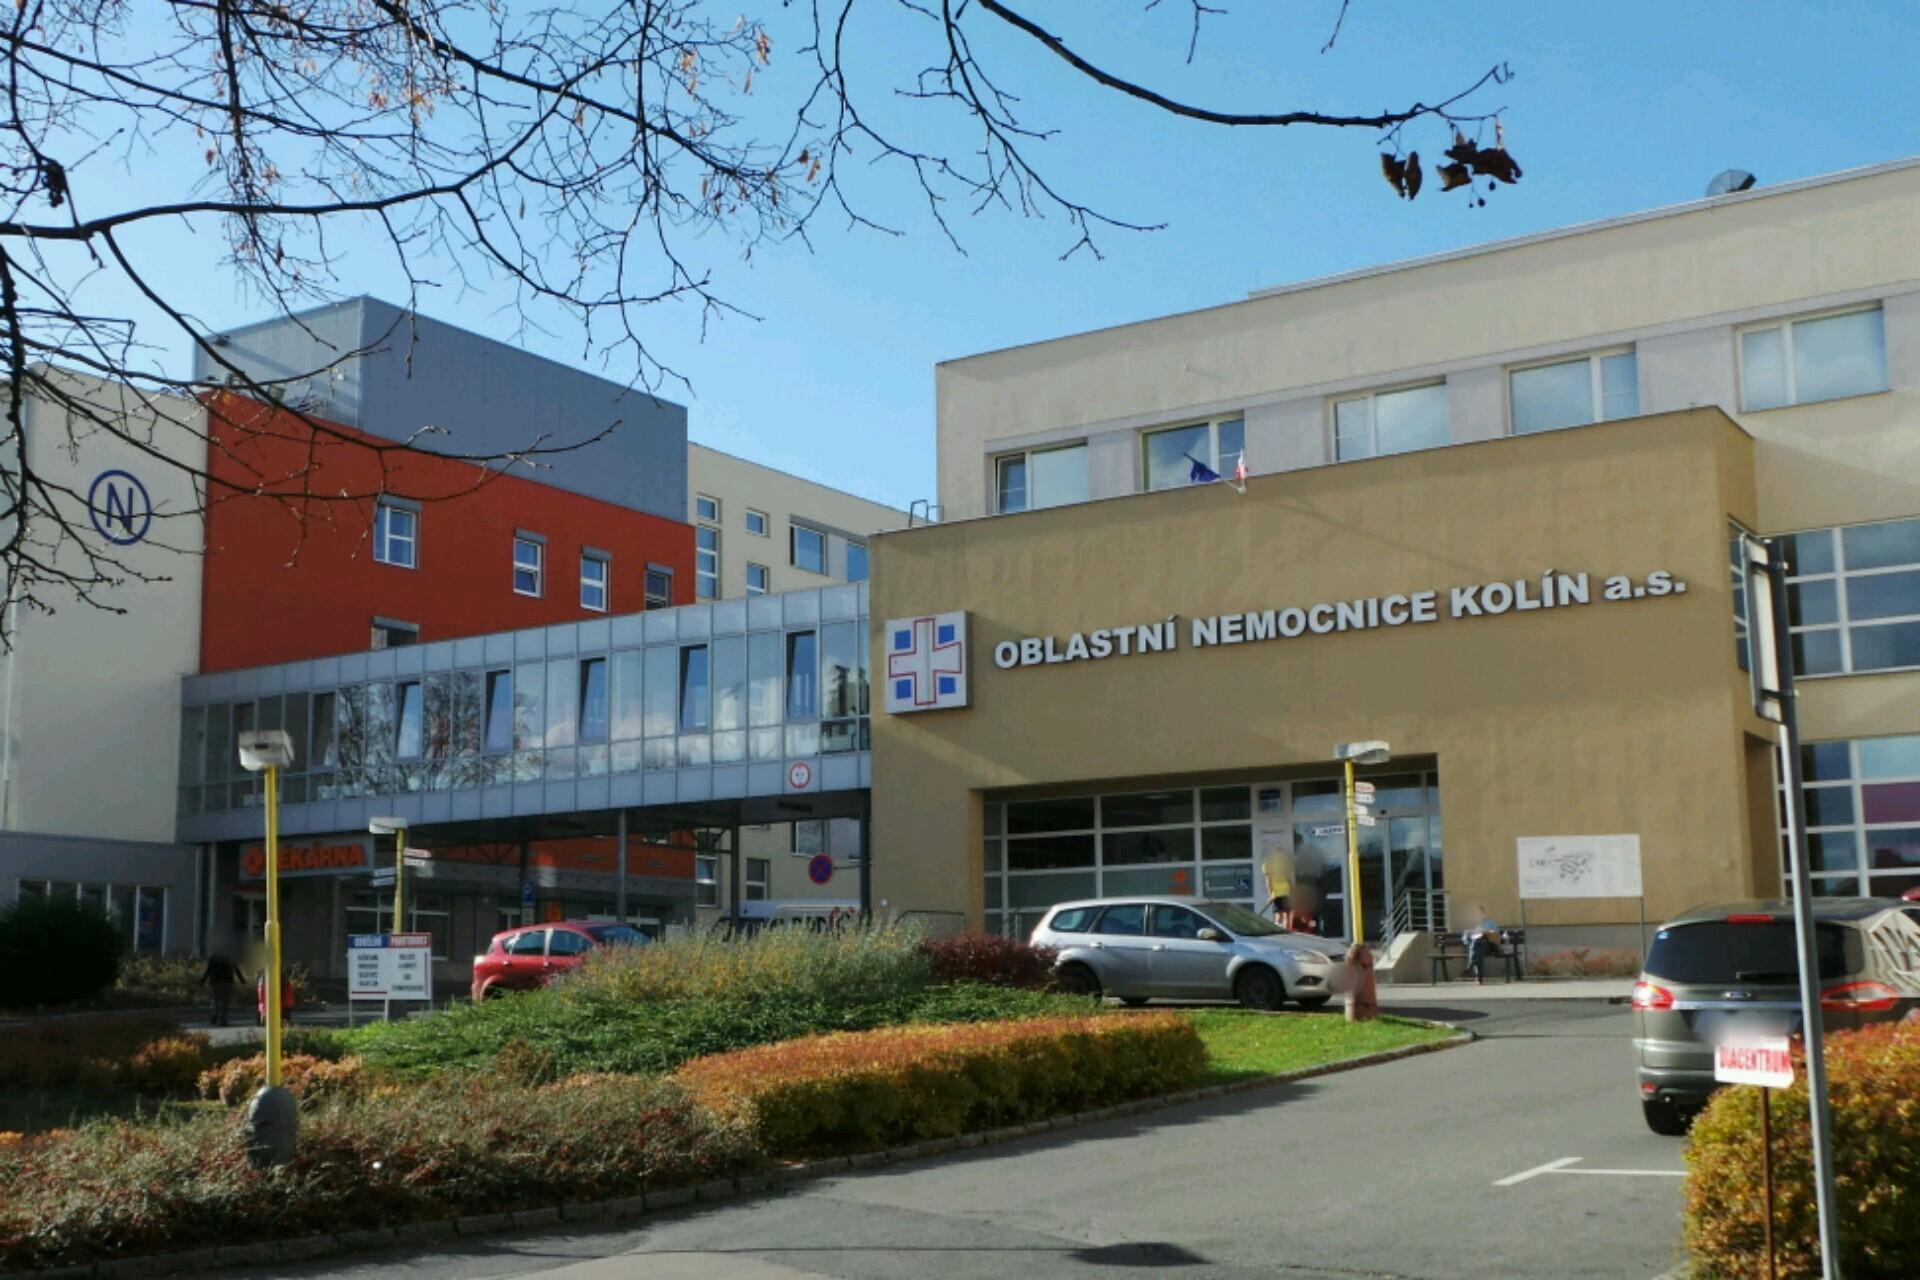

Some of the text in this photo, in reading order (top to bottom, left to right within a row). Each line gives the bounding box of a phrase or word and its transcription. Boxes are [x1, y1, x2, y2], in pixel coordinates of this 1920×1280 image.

[994, 569, 1686, 669] OBLASTNÍ NEMOCNICE KOLÍN a.s.
[268, 841, 367, 870] ÉKÁRNA
[1719, 1046, 1791, 1073] DIACENTRUM
